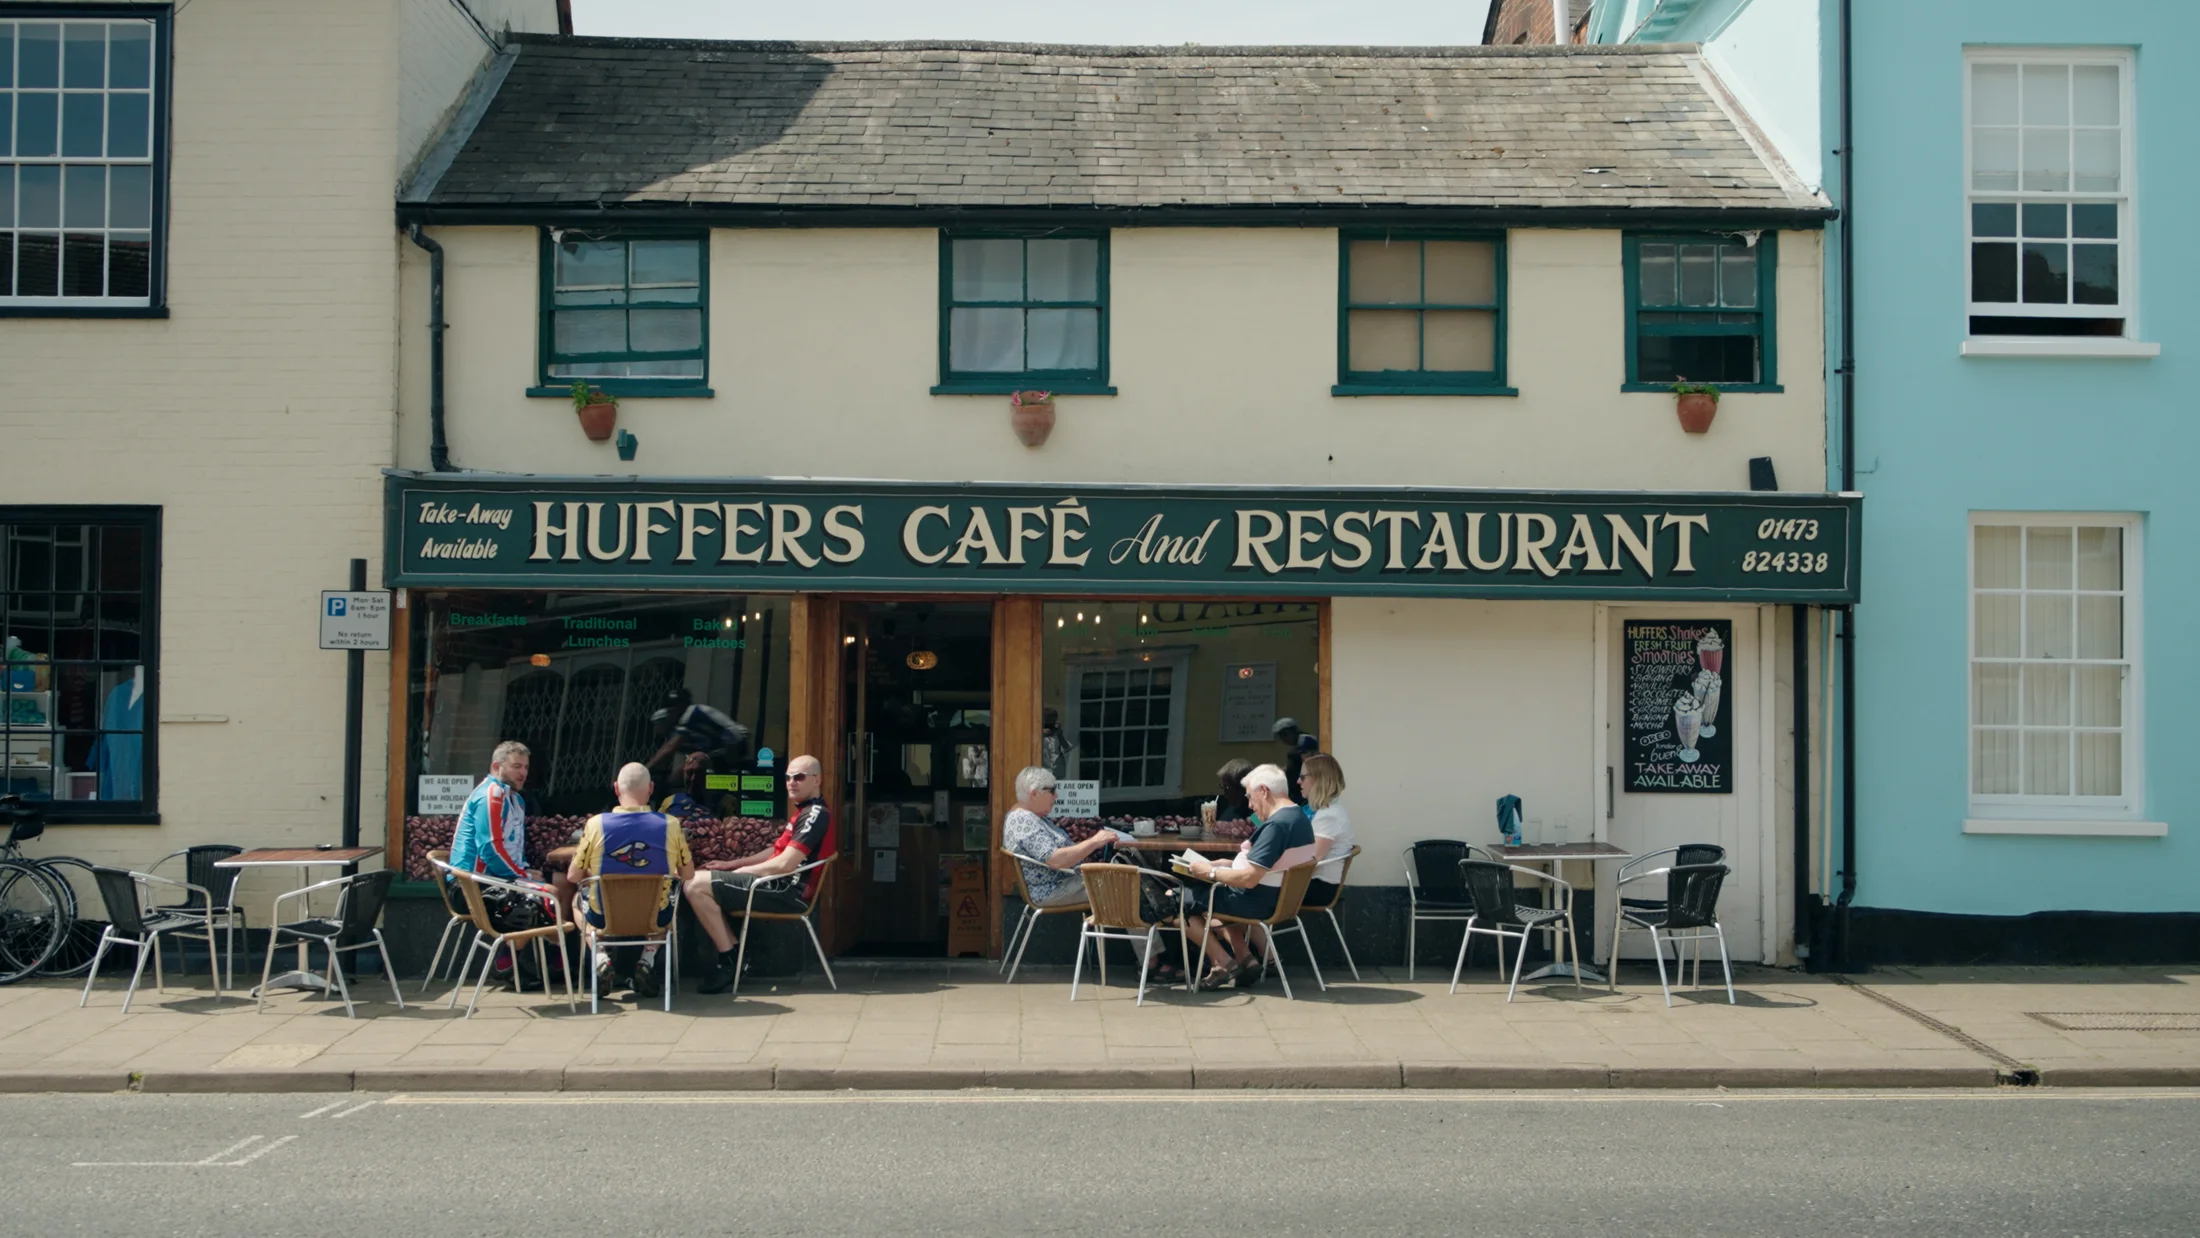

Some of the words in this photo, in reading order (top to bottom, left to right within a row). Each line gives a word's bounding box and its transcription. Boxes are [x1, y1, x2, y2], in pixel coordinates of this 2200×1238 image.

[418, 502, 514, 530] Take-Away
[1757, 518, 1820, 540] 01473
[527, 499, 866, 568] HUFFERS
[902, 496, 1092, 567] CAFÉ
[1108, 513, 1221, 566] And
[1232, 509, 1709, 578] RESTAURANT
[419, 538, 498, 560] Available
[1741, 550, 1828, 574] 824338
[450, 613, 528, 627] Breakfasts
[562, 617, 638, 630] Traditional
[1627, 626, 1667, 640] HUFFERS
[1669, 625, 1708, 640] Shakes
[568, 634, 630, 648] Lunches
[684, 636, 746, 649] Potatoes
[1634, 640, 1662, 650] FRESH
[1664, 640, 1692, 650] FRUIT
[1631, 648, 1696, 665] Smoothies
[1632, 664, 1694, 676] STRAWBERRY
[1634, 674, 1674, 682] BANANA
[1632, 689, 1685, 698] CHOCOLATE
[1632, 698, 1673, 706] CARAMEL
[1631, 706, 1671, 714] CARAMEL
[1632, 714, 1669, 722] BANANA
[1633, 721, 1664, 729] MOCHA
[1640, 730, 1672, 746] OREO
[1633, 774, 1721, 788] AVAILABLE
